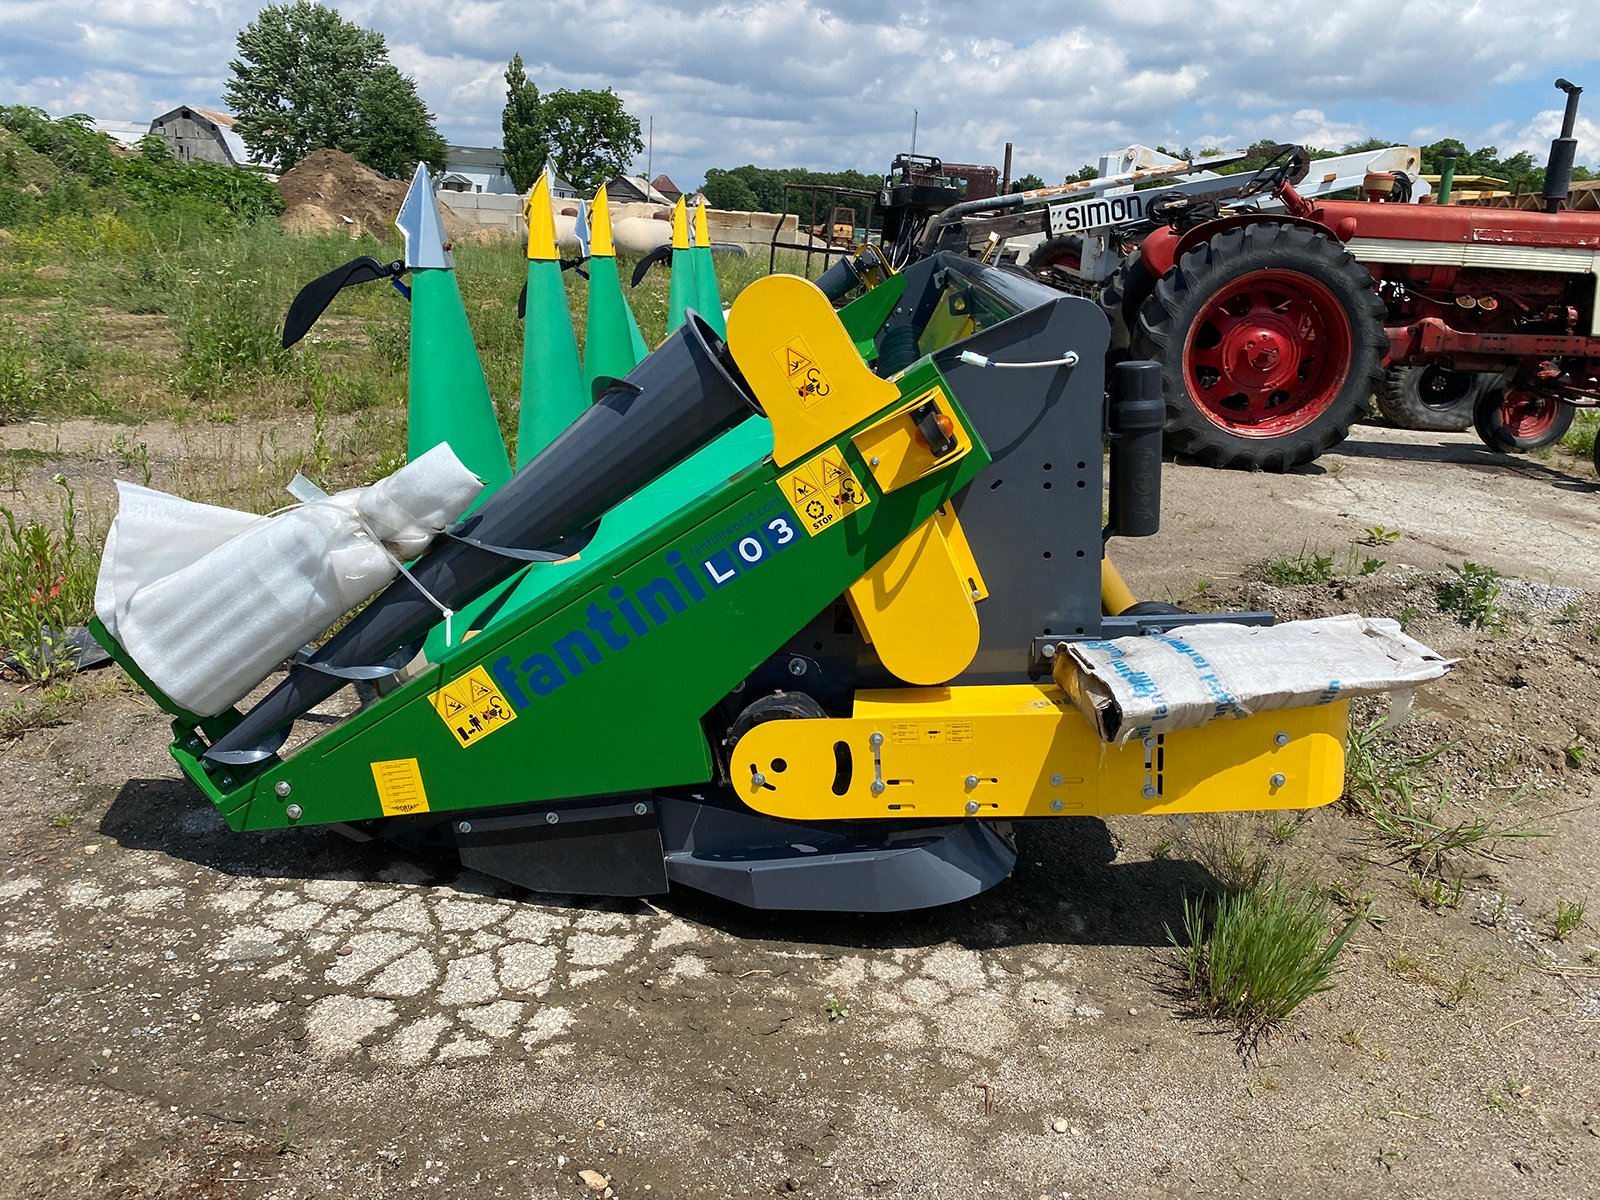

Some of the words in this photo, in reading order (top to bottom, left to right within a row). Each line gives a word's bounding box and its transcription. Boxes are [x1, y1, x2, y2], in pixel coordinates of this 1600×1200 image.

[689, 497, 783, 557] fantiniworld.com
[812, 514, 833, 530] STOP
[492, 550, 708, 710] fantini
